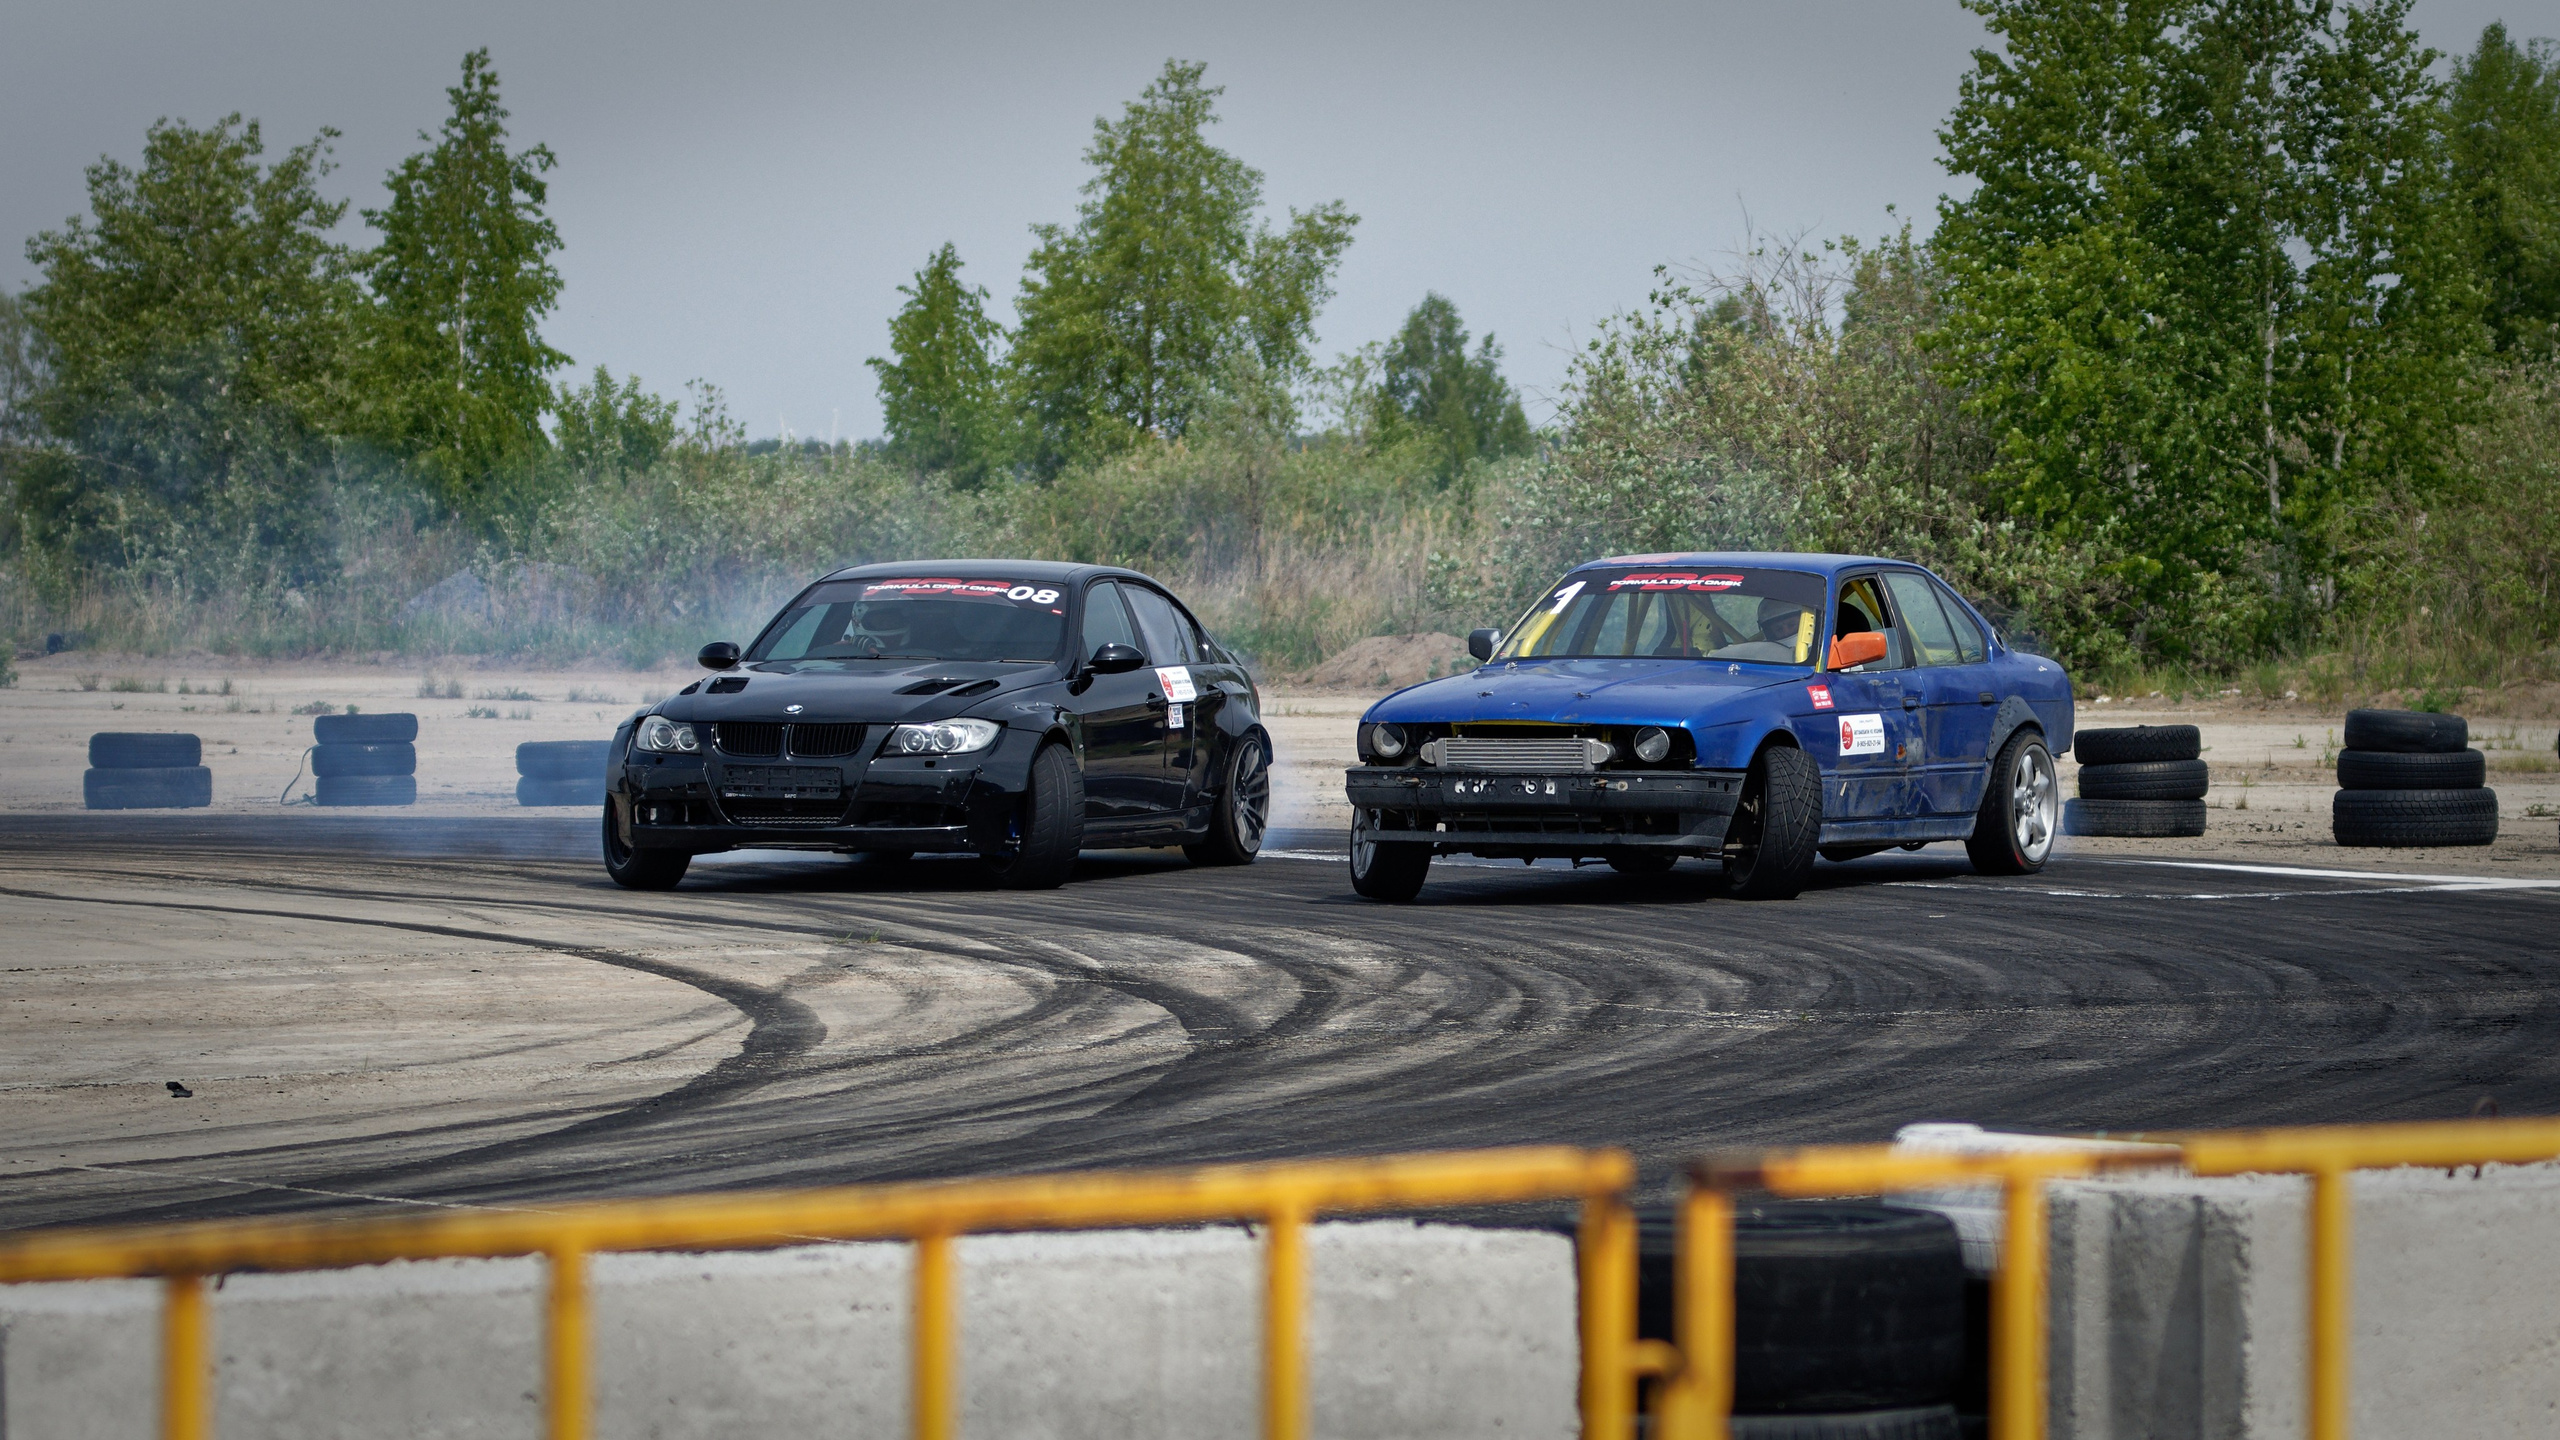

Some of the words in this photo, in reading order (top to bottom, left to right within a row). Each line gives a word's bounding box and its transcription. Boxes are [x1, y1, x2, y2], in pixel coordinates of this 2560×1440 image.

[867, 583, 930, 591] FORMULA
[932, 583, 969, 591] DRIFT
[969, 585, 1010, 594] OMSK
[1007, 586, 1060, 604] 08
[1549, 581, 1587, 615] 1
